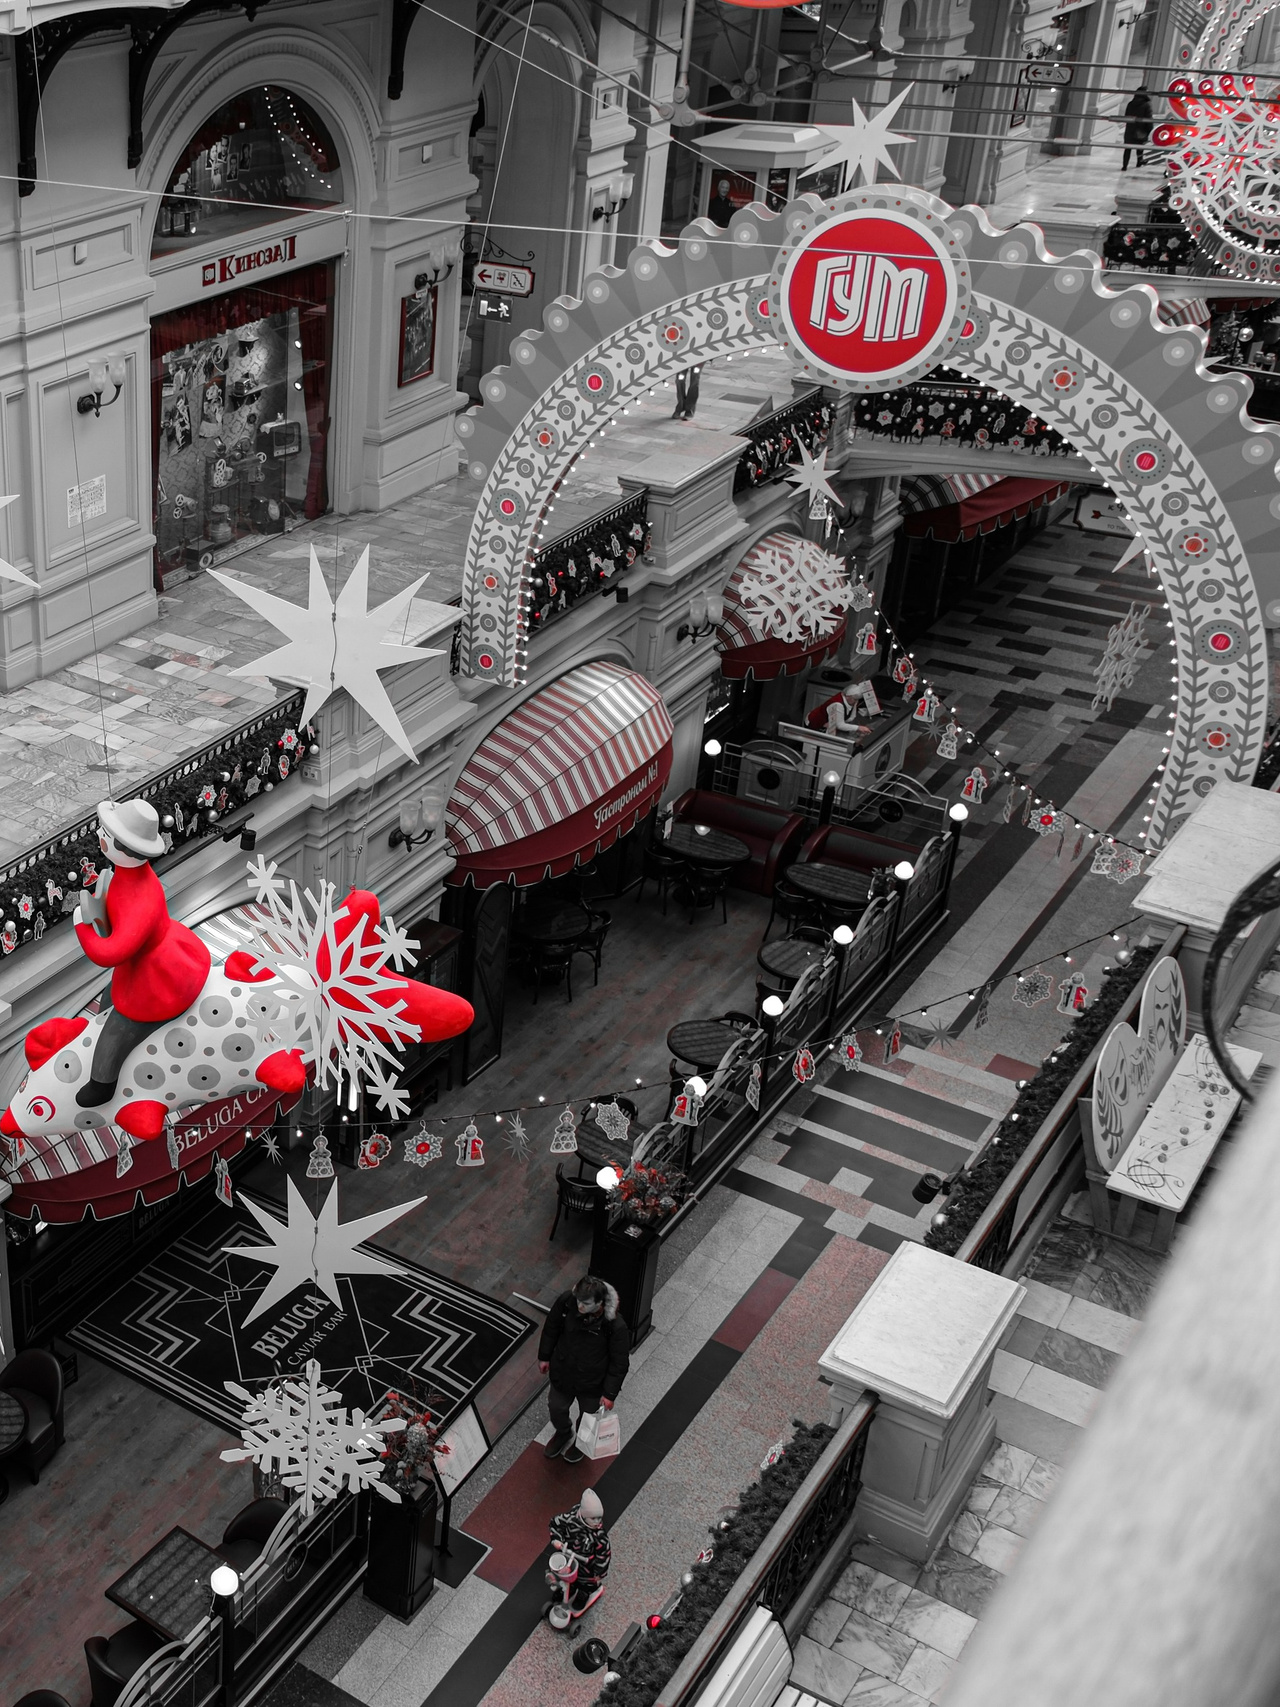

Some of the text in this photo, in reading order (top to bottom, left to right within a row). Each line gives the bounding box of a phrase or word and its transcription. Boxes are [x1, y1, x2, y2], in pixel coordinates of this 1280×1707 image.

[593, 776, 648, 830] Гастроном
[174, 1098, 244, 1153] BELUGA
[250, 1294, 331, 1359] BELUGA
[287, 1310, 348, 1365] CAVIAR BAR
